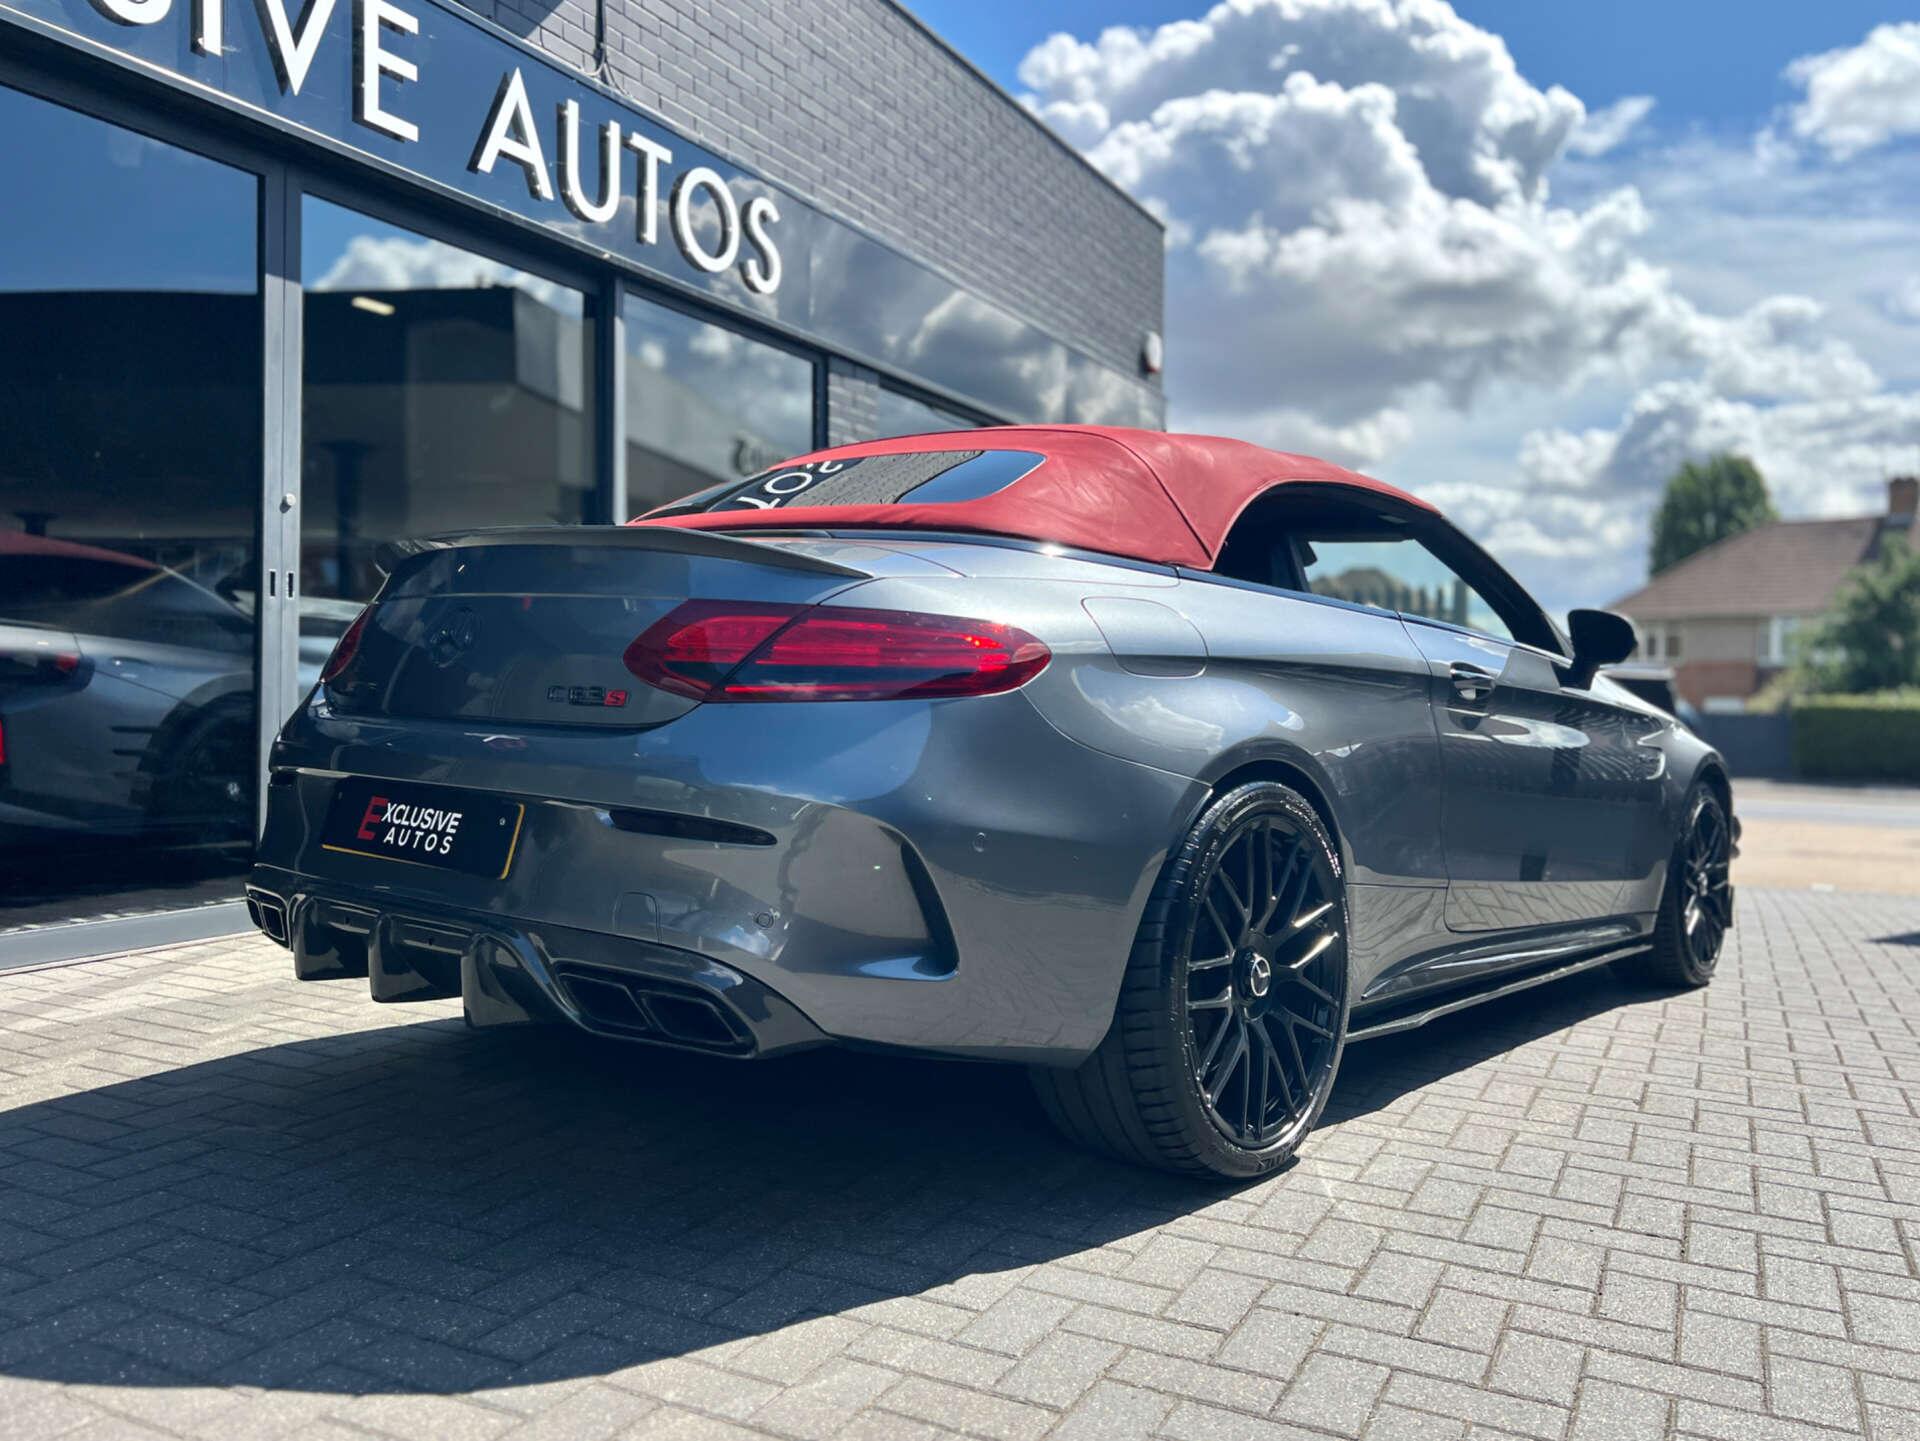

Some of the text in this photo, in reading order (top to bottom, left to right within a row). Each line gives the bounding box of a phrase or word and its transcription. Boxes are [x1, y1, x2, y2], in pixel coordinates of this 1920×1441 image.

[470, 66, 782, 294] AUTOS
[356, 795, 463, 841] EXCLUSIVE
[383, 827, 454, 855] AUTOS
